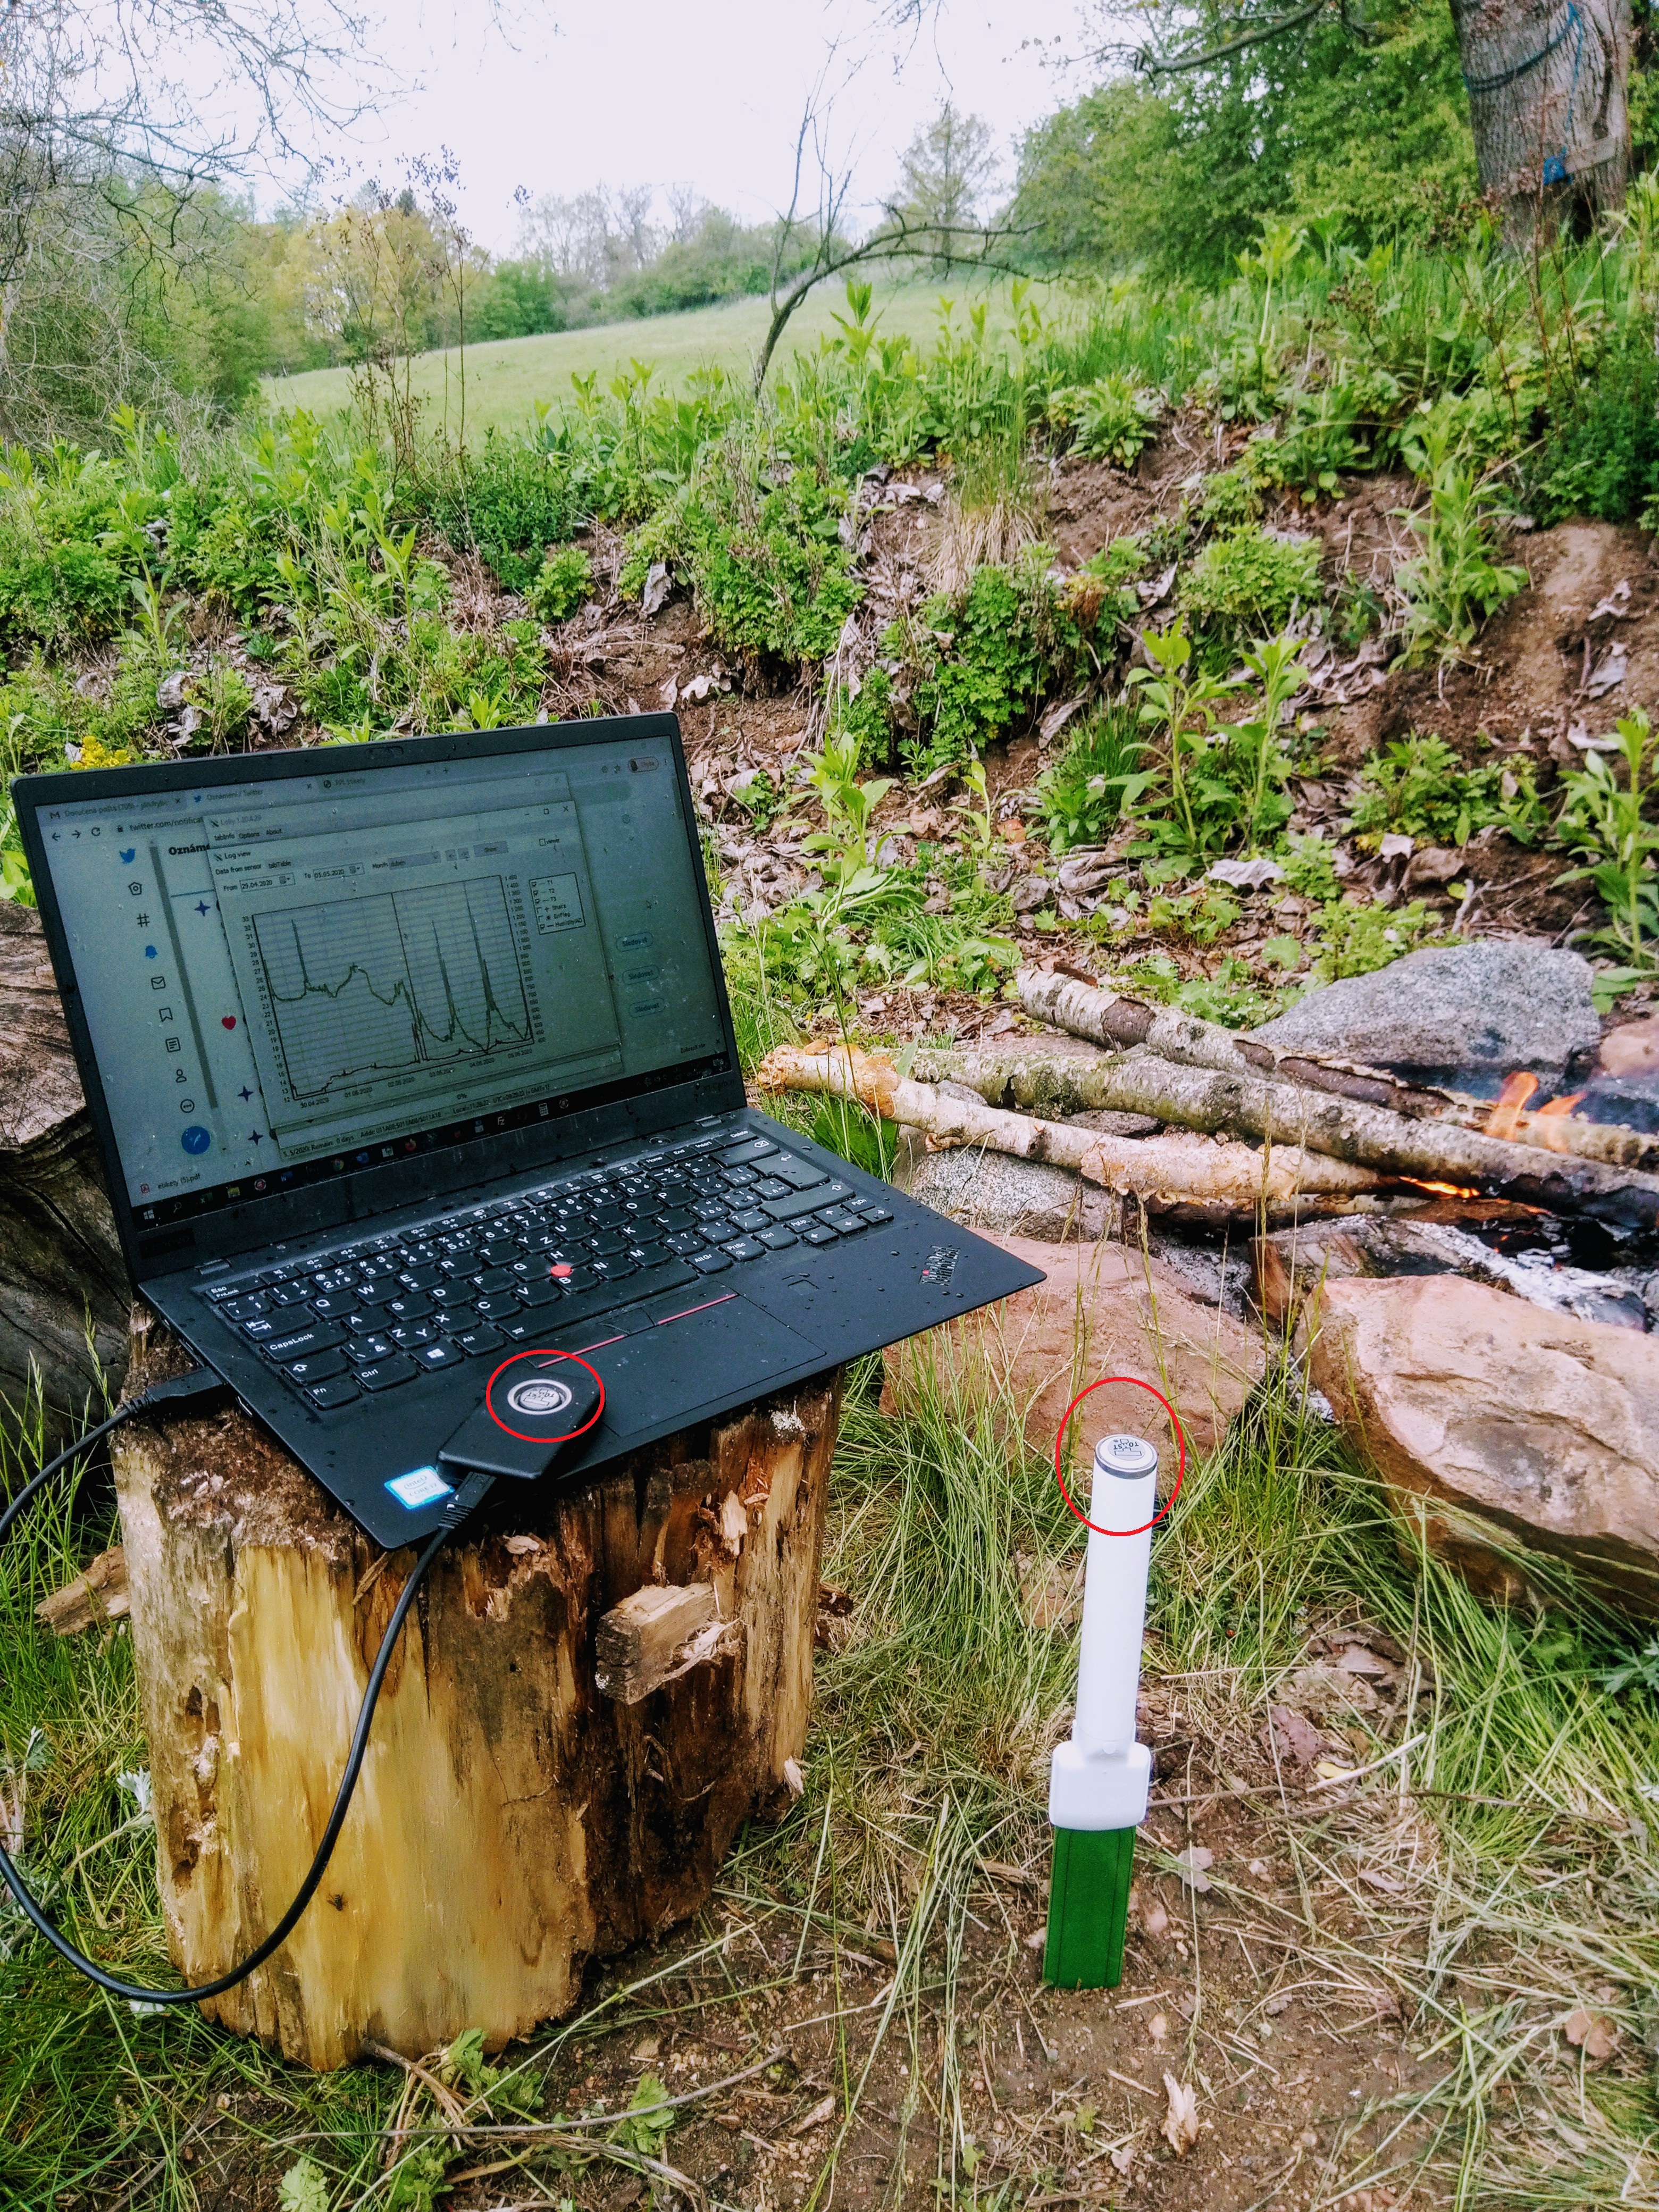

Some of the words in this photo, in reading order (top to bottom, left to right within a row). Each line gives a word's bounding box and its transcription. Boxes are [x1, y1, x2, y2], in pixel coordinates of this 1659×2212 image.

[224, 852, 237, 861] Log
[268, 860, 291, 869] tabTable
[241, 879, 273, 890] 29.04.2020
[358, 1285, 374, 1294] W
[392, 1329, 406, 1337] Z
[270, 1334, 314, 1350] CapsLock
[407, 1477, 424, 1487] intel
